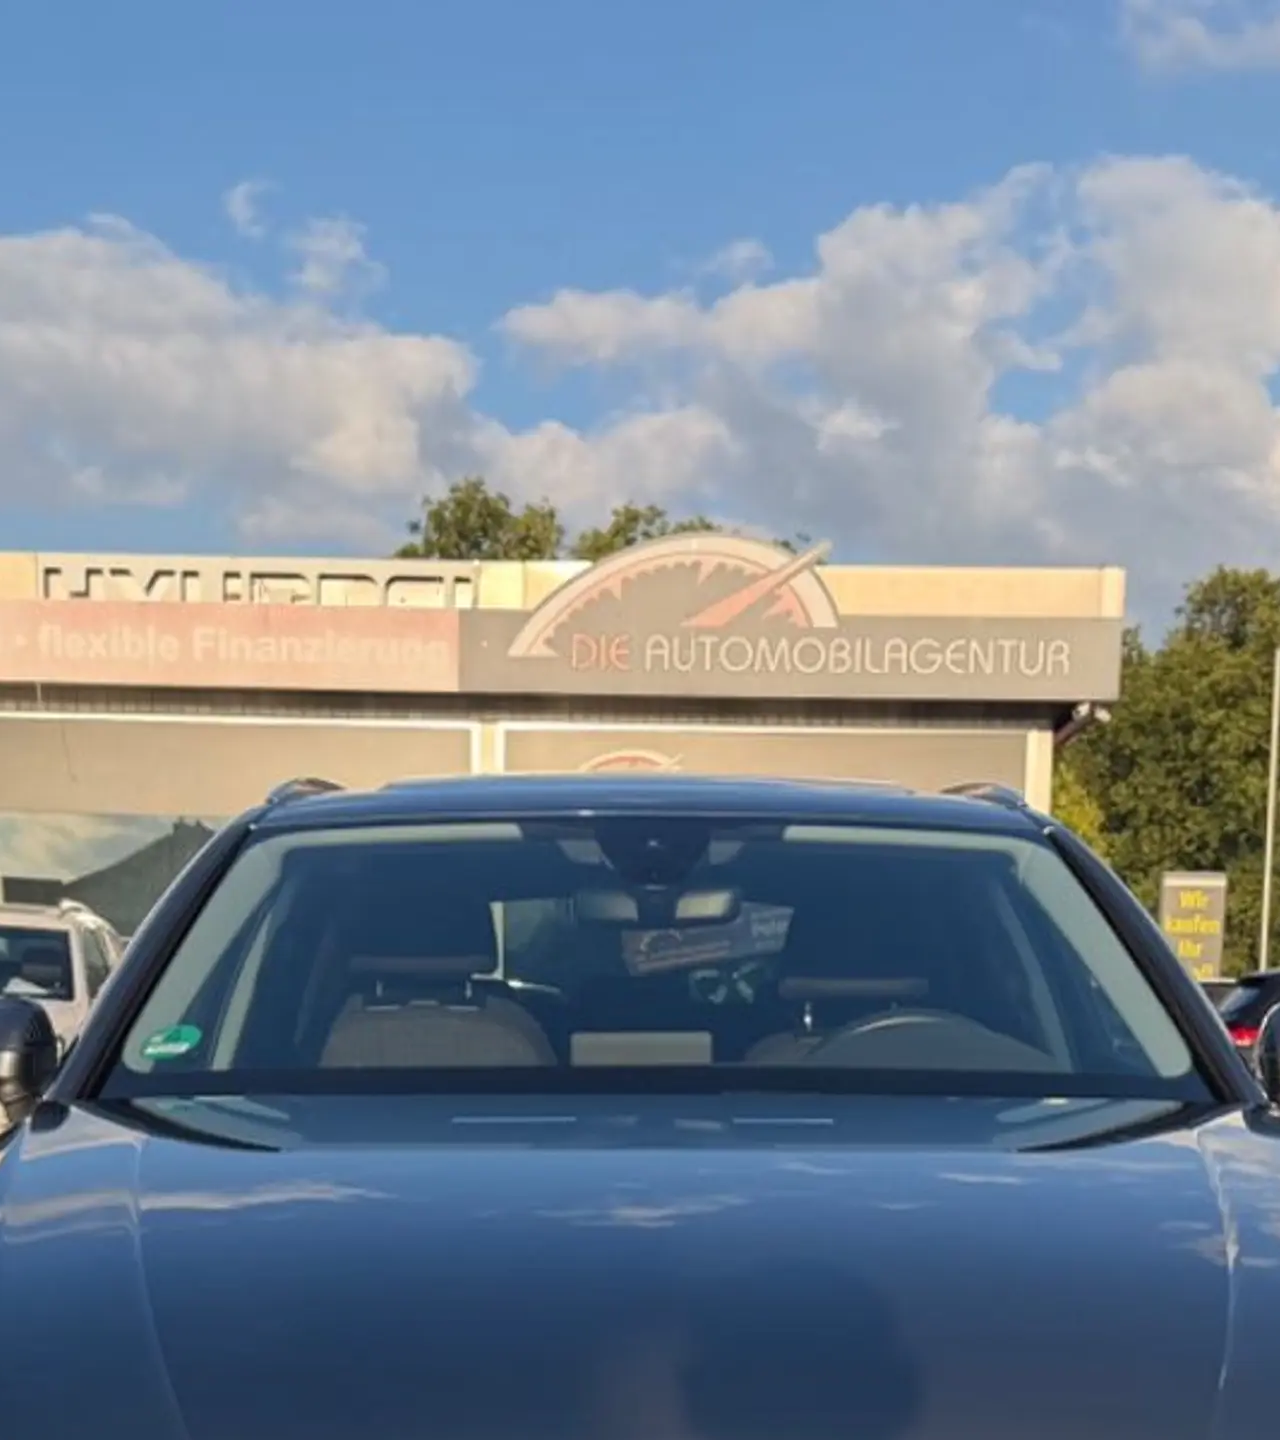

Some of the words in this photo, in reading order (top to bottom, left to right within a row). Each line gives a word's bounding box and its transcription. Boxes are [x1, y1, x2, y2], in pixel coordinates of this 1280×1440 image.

[38, 623, 180, 663] flexible
[193, 627, 450, 671] Finanzierung
[570, 632, 630, 671] DIE
[645, 633, 1071, 678] AUTOMOBILAGENTUR
